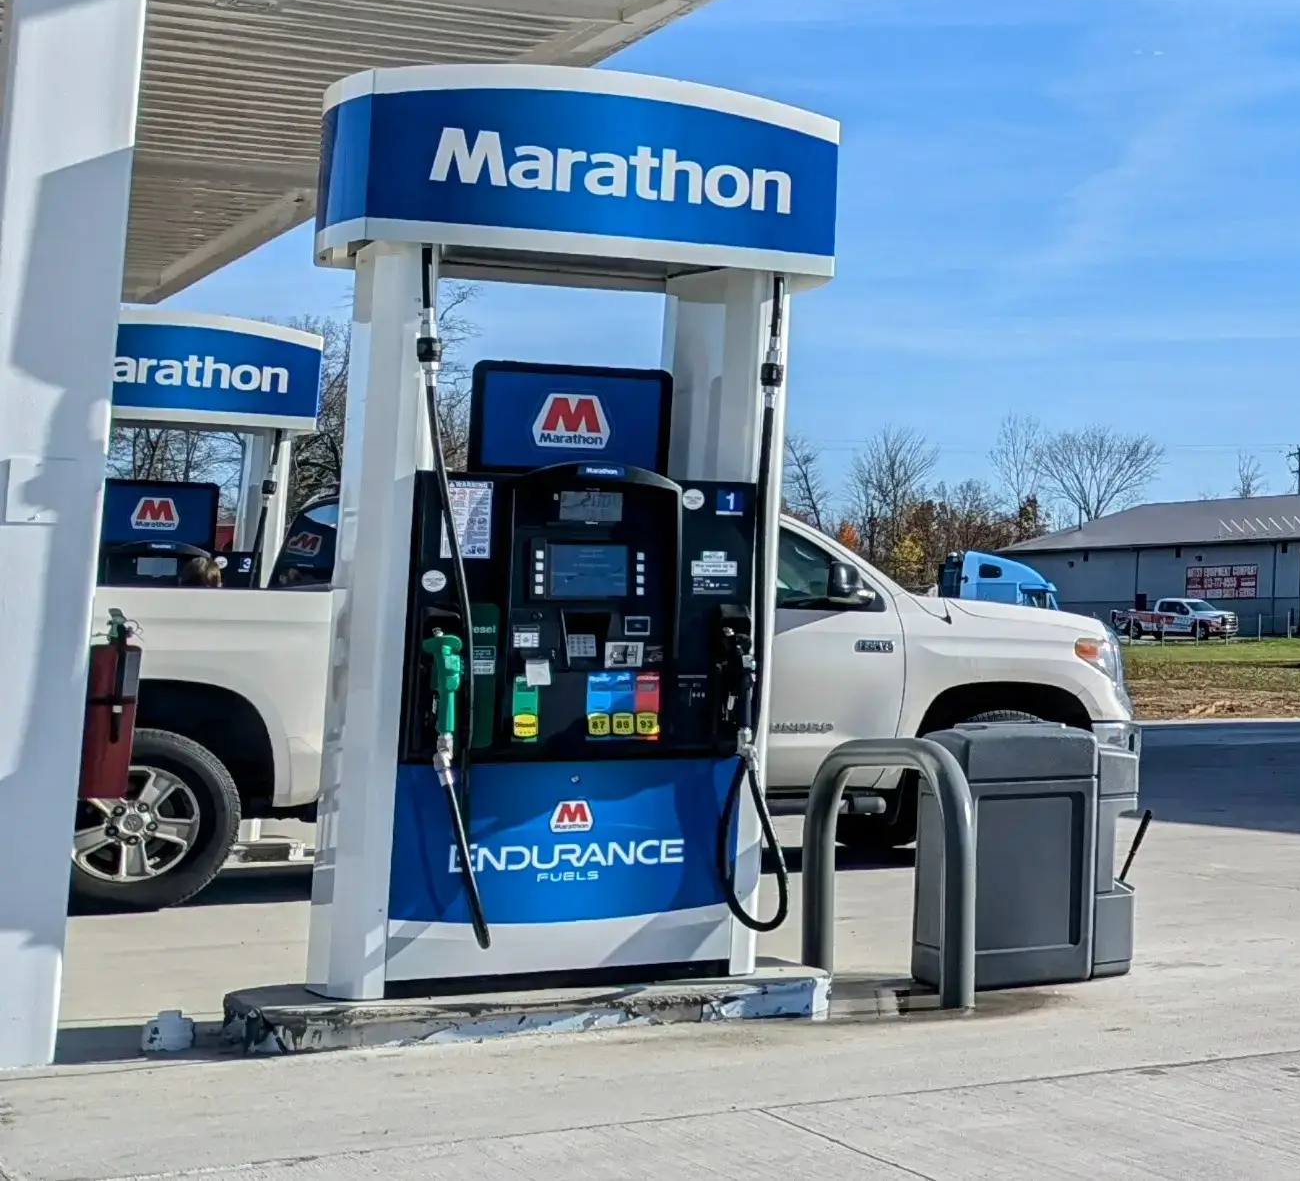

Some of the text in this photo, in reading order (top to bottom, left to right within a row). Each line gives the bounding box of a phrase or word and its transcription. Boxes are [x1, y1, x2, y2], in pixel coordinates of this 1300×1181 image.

[429, 127, 791, 215] Marathon
[113, 355, 289, 394] arathon
[538, 432, 604, 446] Marathon
[726, 492, 735, 510] 1
[473, 624, 496, 634] esel
[592, 720, 606, 730] 87
[553, 822, 590, 830] Marathon
[448, 839, 685, 873] ENDURANCE
[536, 871, 599, 882] FUELS
